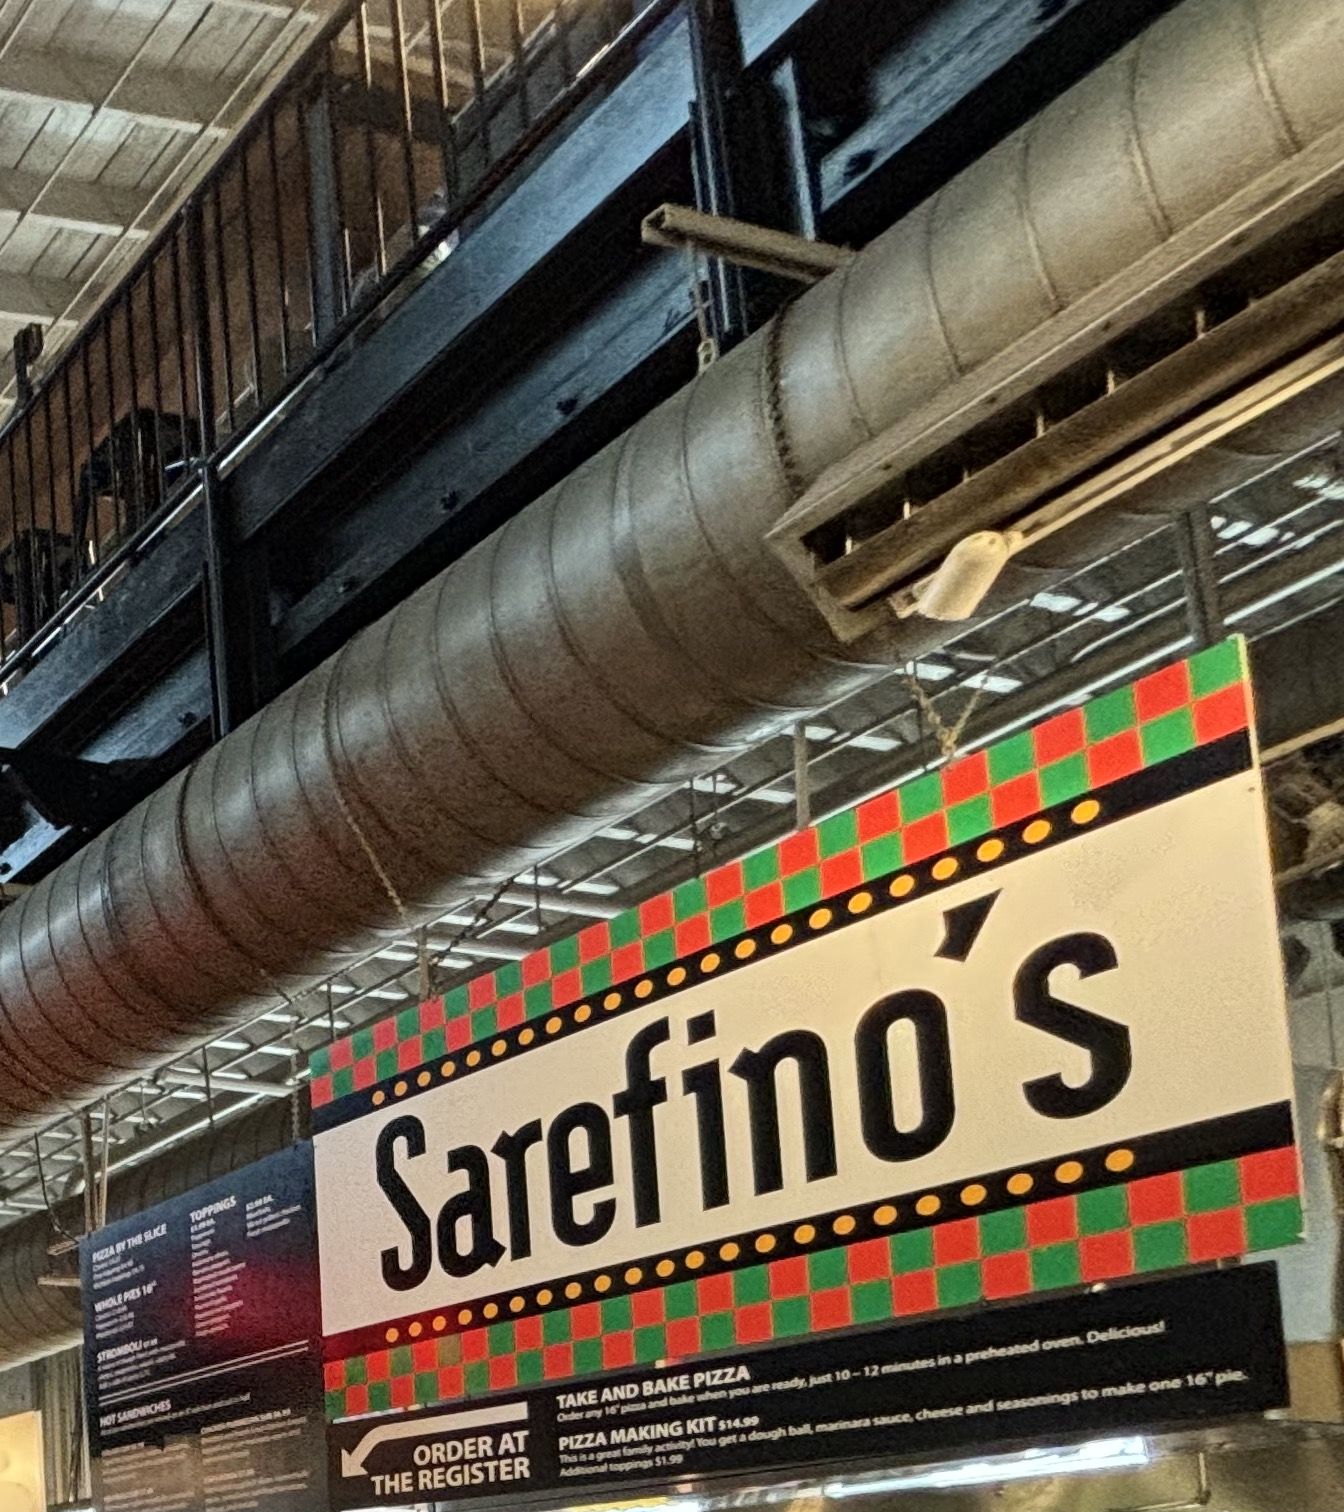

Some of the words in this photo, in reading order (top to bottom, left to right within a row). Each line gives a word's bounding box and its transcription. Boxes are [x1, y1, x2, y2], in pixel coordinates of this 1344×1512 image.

[374, 887, 1133, 1293] Sarefino's
[190, 1195, 237, 1222] TOPPINGS
[92, 1245, 115, 1263] PIZZA
[115, 1240, 126, 1255] BY
[127, 1233, 143, 1249] THE
[143, 1222, 167, 1242] SLICE
[94, 1293, 123, 1312] WHOLE
[556, 1390, 598, 1409] TAKE
[601, 1384, 639, 1402] AND
[642, 1374, 690, 1396] BAKE
[693, 1365, 751, 1388] PIZZA
[557, 1411, 584, 1422] Order
[585, 1409, 602, 1419] any
[620, 1402, 647, 1414] pizza
[648, 1397, 668, 1409] and
[669, 1394, 695, 1405] bake
[696, 1390, 727, 1402] when
[729, 1387, 750, 1399] you
[752, 1383, 770, 1394] are
[809, 1374, 833, 1388] just
[834, 1369, 850, 1381] 10
[864, 1365, 879, 1377] 12
[881, 1358, 936, 1374] minutes
[937, 1354, 952, 1366] in
[953, 1354, 963, 1364] a
[965, 1339, 1040, 1365] preheated
[1042, 1336, 1084, 1351] oven.
[1086, 1320, 1165, 1343] Delicious!
[99, 1413, 116, 1428] HOT
[117, 1399, 172, 1422] SANDWICHES
[559, 1454, 578, 1464] This
[579, 1452, 587, 1462] is
[588, 1453, 595, 1461] a
[596, 1449, 621, 1461] great
[622, 1446, 653, 1456] family
[696, 1438, 717, 1447] You
[718, 1434, 738, 1447] get
[739, 1433, 747, 1442] a
[748, 1426, 787, 1440] dough
[815, 1418, 871, 1433] marinara
[872, 1412, 914, 1426] sauce,
[915, 1407, 963, 1422] cheese
[965, 1399, 994, 1414] and
[996, 1391, 1079, 1411] seasonings
[1081, 1389, 1099, 1400] to
[1101, 1381, 1146, 1398] make
[1148, 1378, 1182, 1392] one
[413, 1435, 493, 1466] ORDER
[498, 1430, 530, 1455] AT
[558, 1431, 607, 1451] PIZZA
[610, 1421, 683, 1445] MAKING
[686, 1416, 717, 1435] KIT
[718, 1415, 760, 1431] $14.99
[370, 1471, 413, 1495] THE
[418, 1457, 530, 1490] REGISTER
[559, 1462, 608, 1477] Additional
[609, 1459, 653, 1472] toppings
[654, 1454, 684, 1467] $1.99
